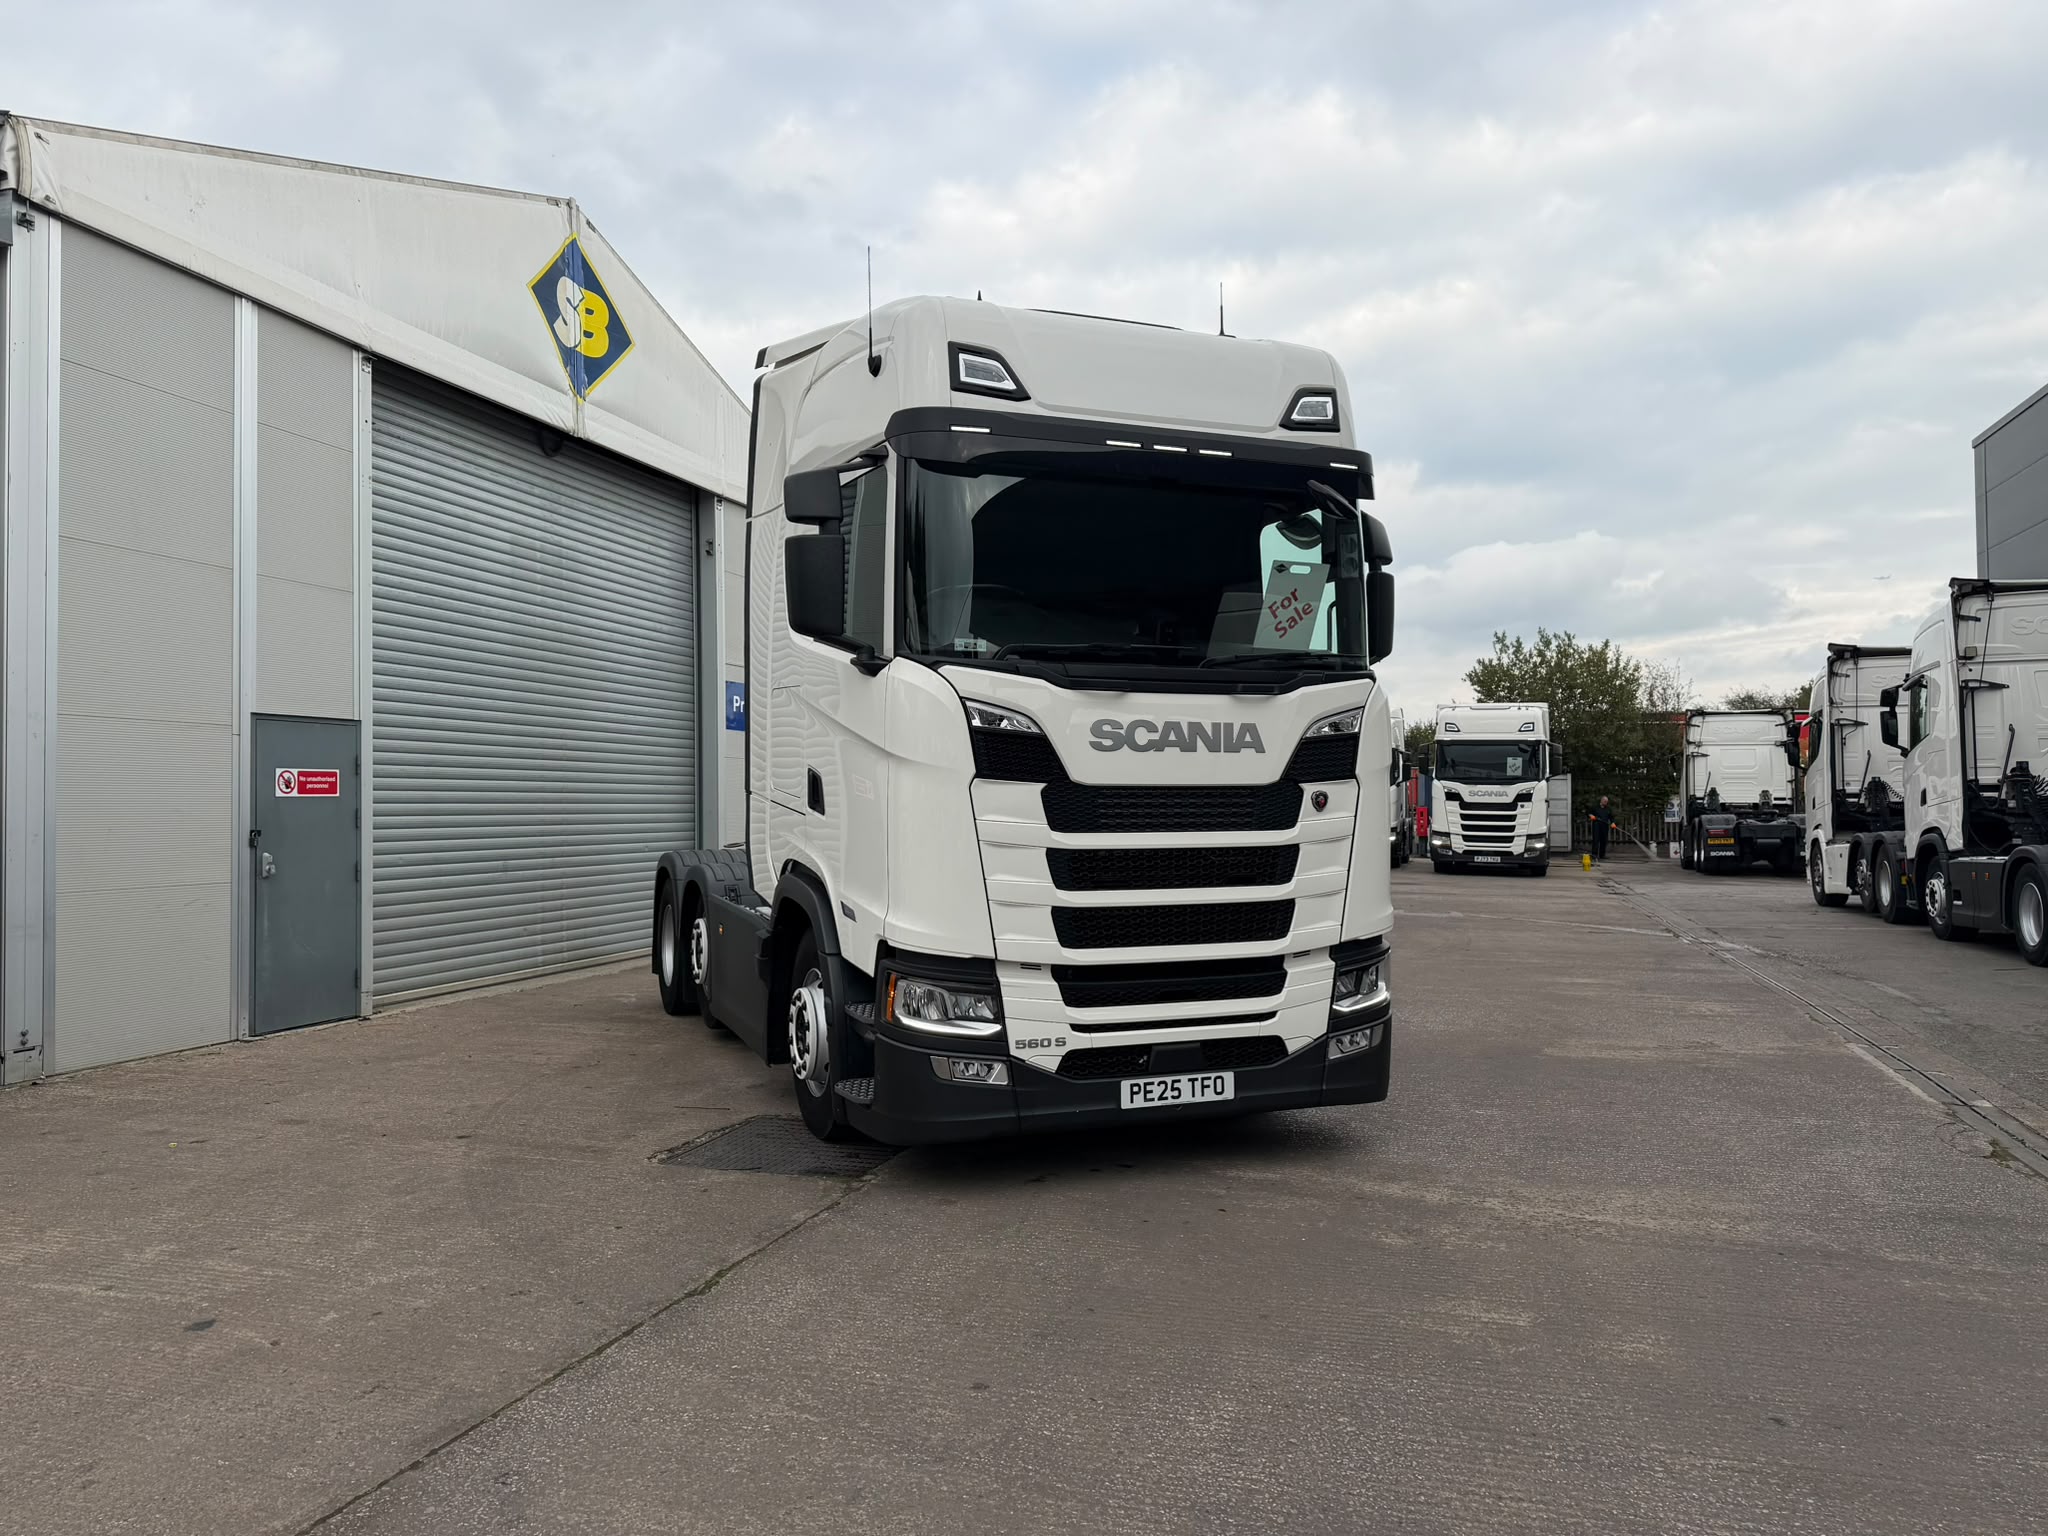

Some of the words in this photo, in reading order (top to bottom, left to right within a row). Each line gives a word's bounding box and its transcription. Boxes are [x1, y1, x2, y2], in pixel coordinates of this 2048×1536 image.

[553, 276, 610, 358] SB
[1268, 588, 1299, 620] For
[1274, 602, 1314, 639] Sale
[1088, 718, 1267, 754] SCANIA
[1468, 790, 1509, 798] SCANIA
[1015, 1037, 1052, 1050] 560
[1054, 1036, 1067, 1047] S
[1129, 1079, 1182, 1104] PE25
[1187, 1075, 1225, 1099] TFO
